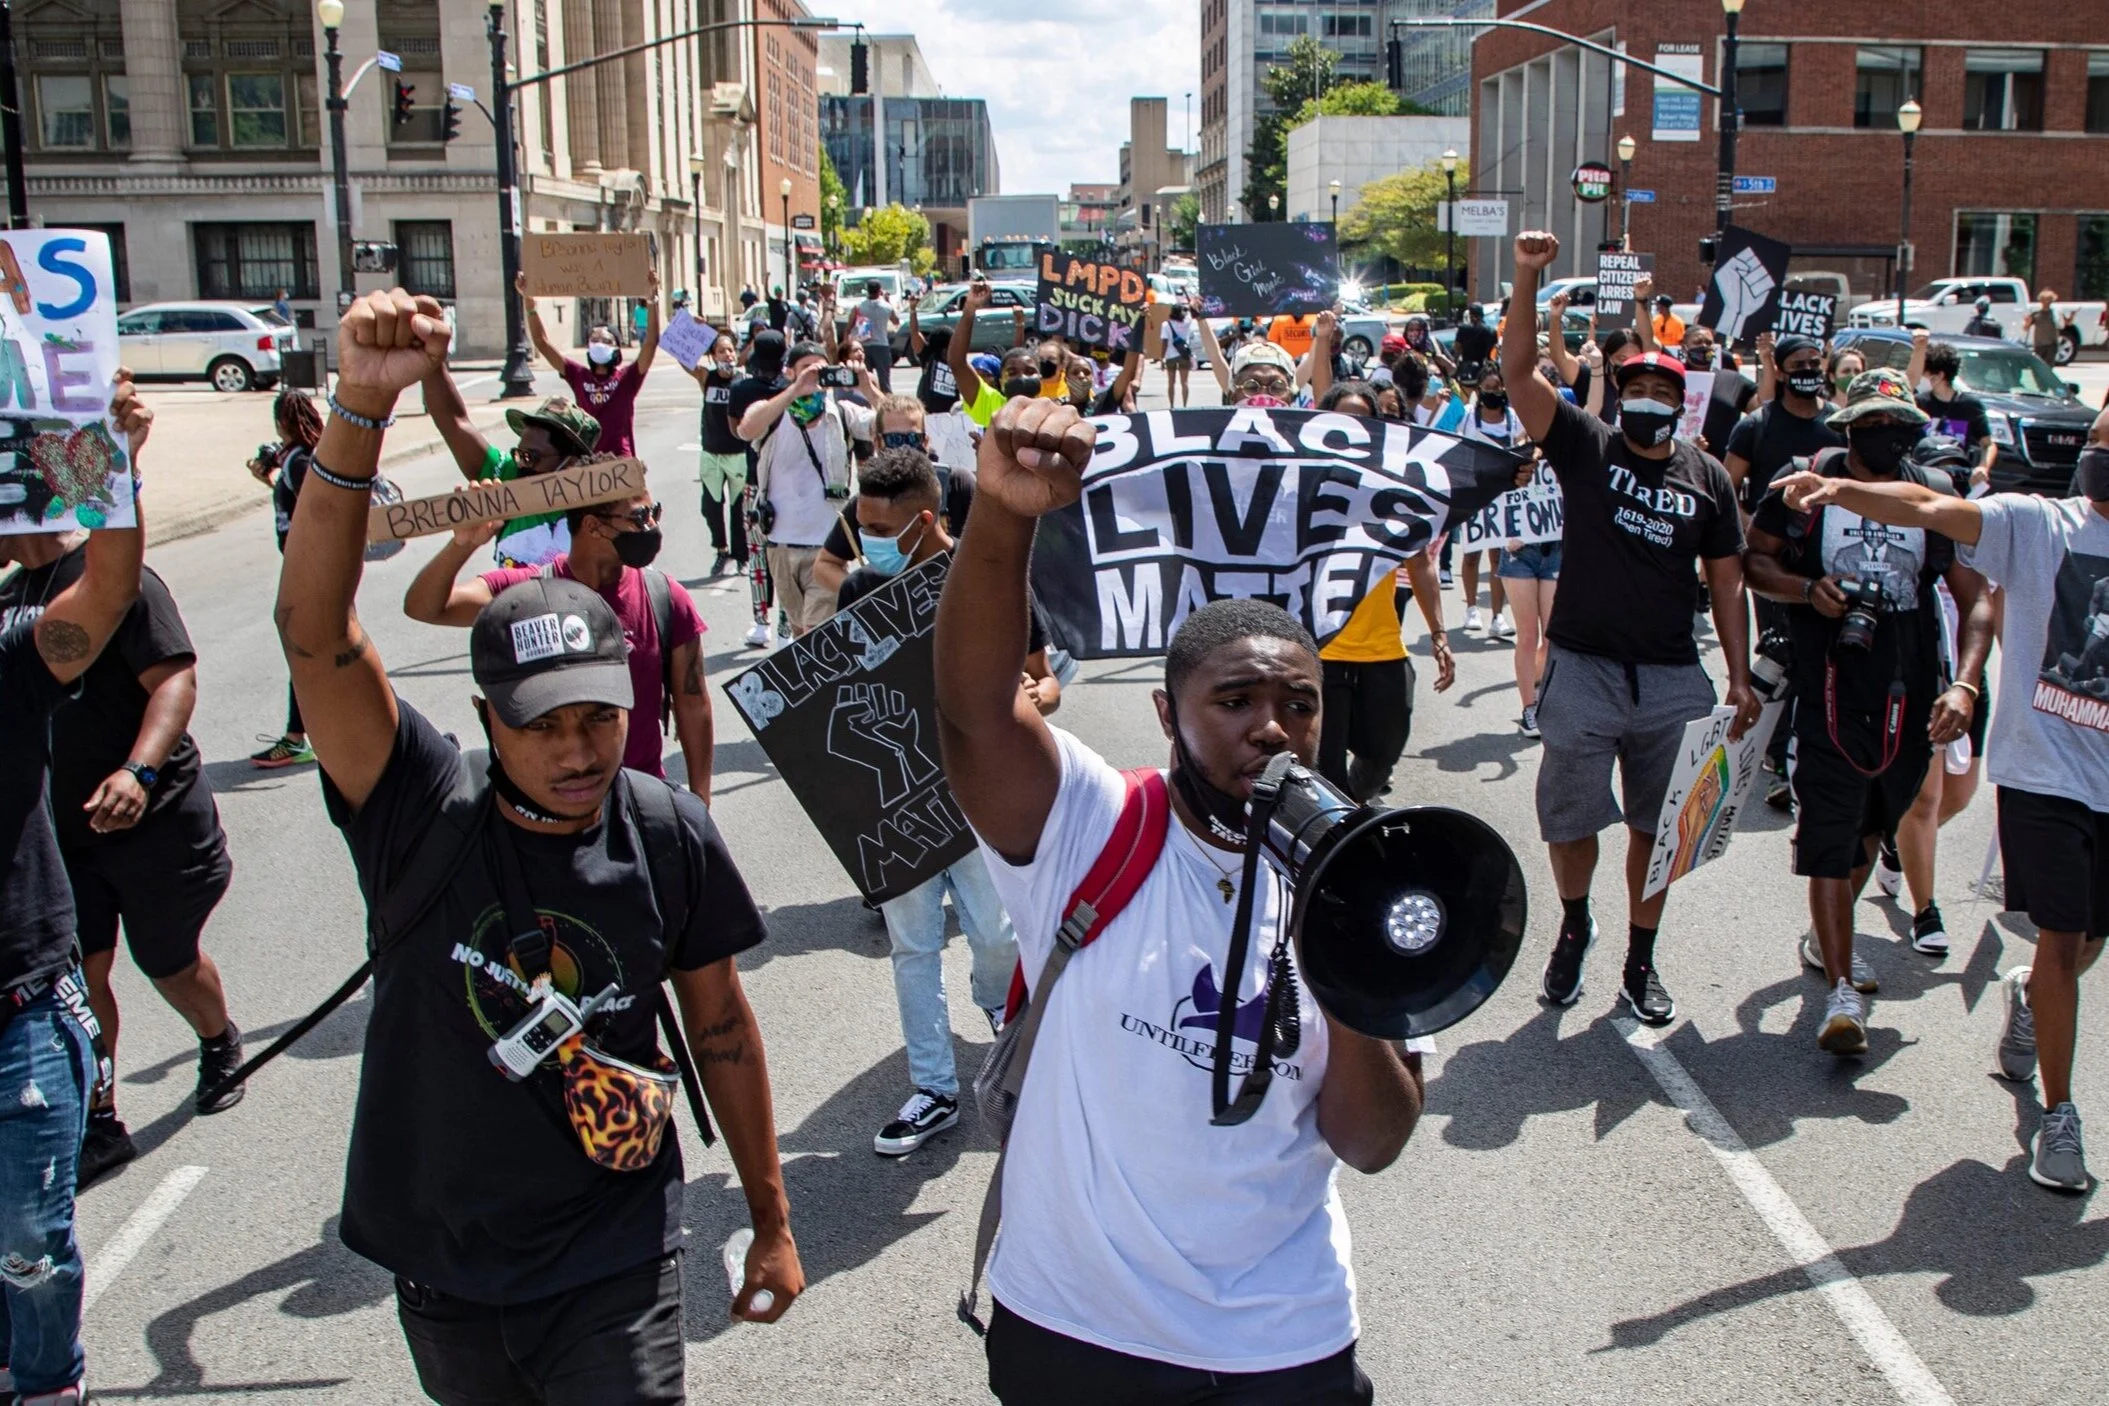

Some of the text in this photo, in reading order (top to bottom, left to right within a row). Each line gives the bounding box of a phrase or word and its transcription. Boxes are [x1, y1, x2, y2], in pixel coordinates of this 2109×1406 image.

[1658, 44, 1700, 53] FOR LEASE
[1577, 169, 1611, 183] Pita
[1582, 183, 1607, 195] Pit
[1748, 178, 1764, 189] 5th
[1461, 206, 1505, 216] MELBA'S
[1600, 255, 1641, 270] REPEAL
[1042, 253, 1144, 304] LMPD
[1598, 285, 1635, 300] ARRES
[1778, 290, 1834, 316] LACK
[1049, 287, 1105, 316] SUCK
[1108, 304, 1142, 329] MY
[1598, 300, 1623, 314] LAW
[1039, 302, 1132, 348] DICK
[1772, 310, 1826, 337] IVES
[1082, 408, 1463, 501] BLACK
[387, 487, 521, 538] BREONNA
[532, 462, 633, 508] TAYLOR
[1506, 490, 1530, 504] FOR
[1609, 464, 1697, 518] TIRED
[1087, 460, 1438, 557] LIVES
[1466, 498, 1563, 543] BREONN
[1617, 507, 1674, 536] 1619-2020
[514, 618, 557, 639] BEAVER
[516, 632, 560, 652] HUNTER
[727, 611, 868, 731] BLACK
[857, 777, 969, 893] MATT
[1650, 789, 1682, 883] BLACK
[450, 943, 485, 967] NO
[54, 974, 101, 1040] EME
